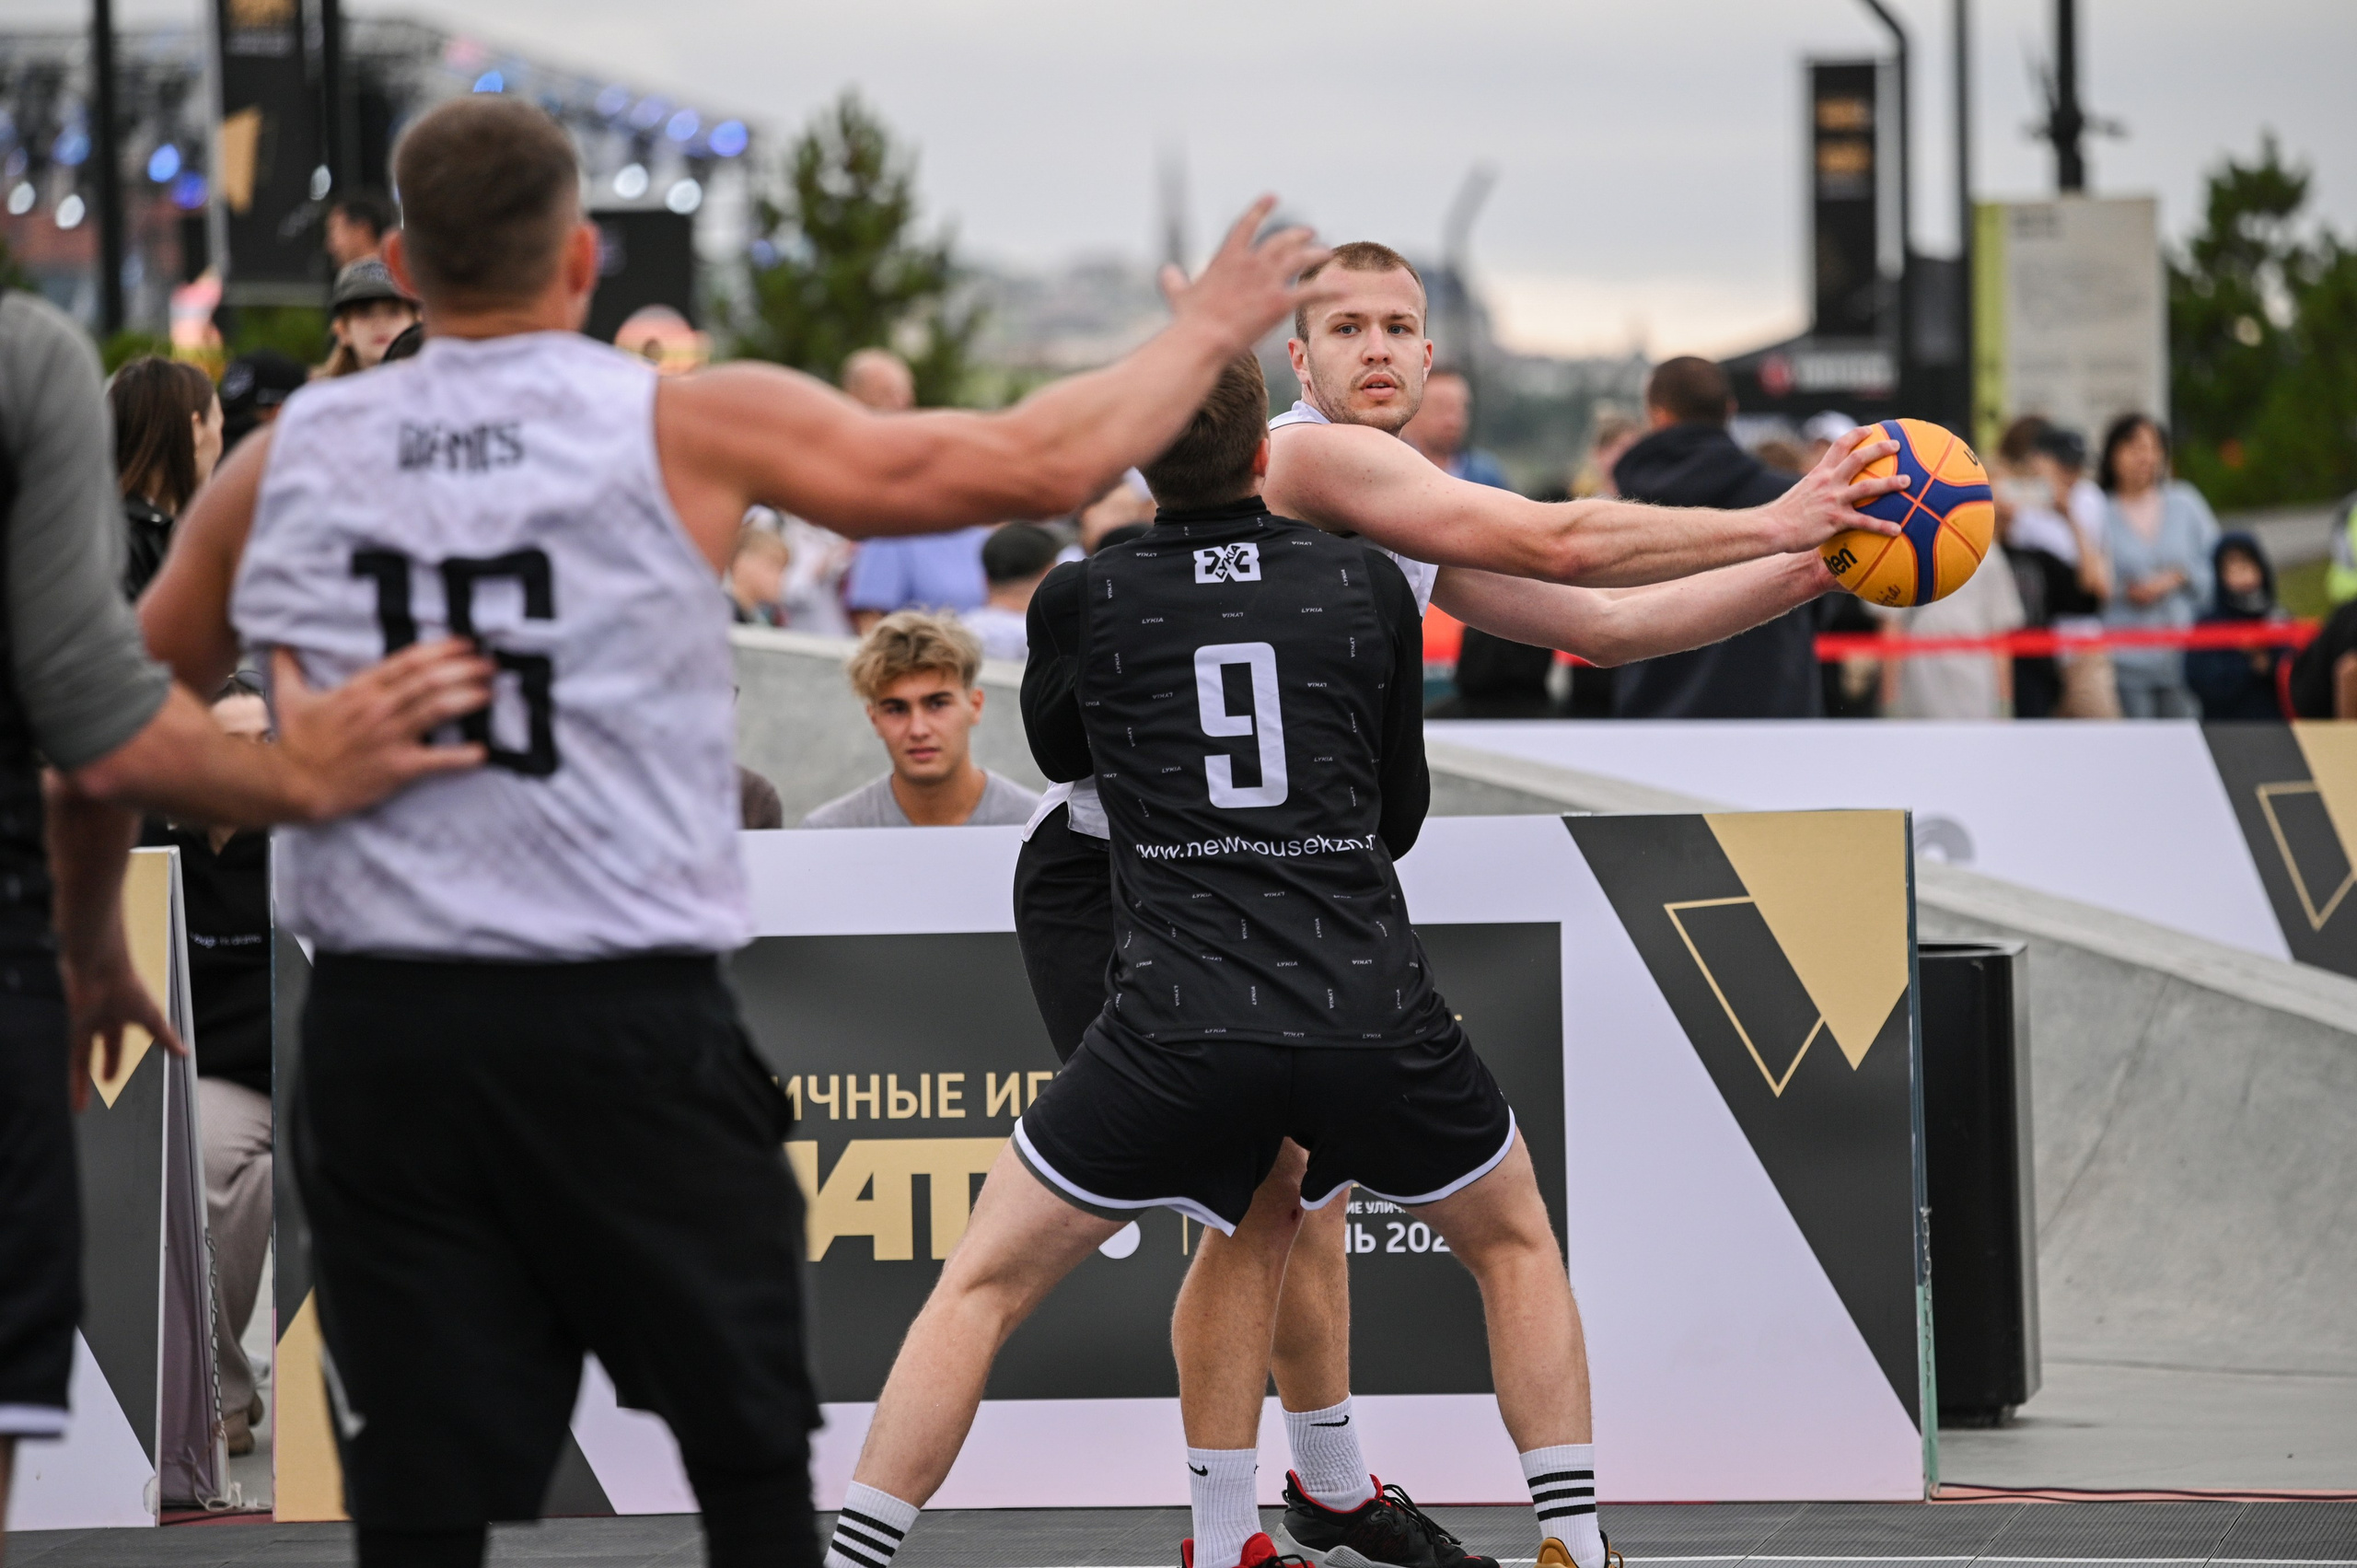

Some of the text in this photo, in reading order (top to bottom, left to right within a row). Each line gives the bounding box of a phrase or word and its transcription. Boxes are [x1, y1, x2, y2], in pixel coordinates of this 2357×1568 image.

[1215, 545, 1241, 579] LYKIA
[346, 541, 562, 780] 16
[1194, 642, 1287, 808] 9
[1135, 834, 1376, 860] ww.newhousekzn.r
[984, 1070, 1061, 1119] ИГ
[1365, 1201, 1407, 1214] УЛИЧ
